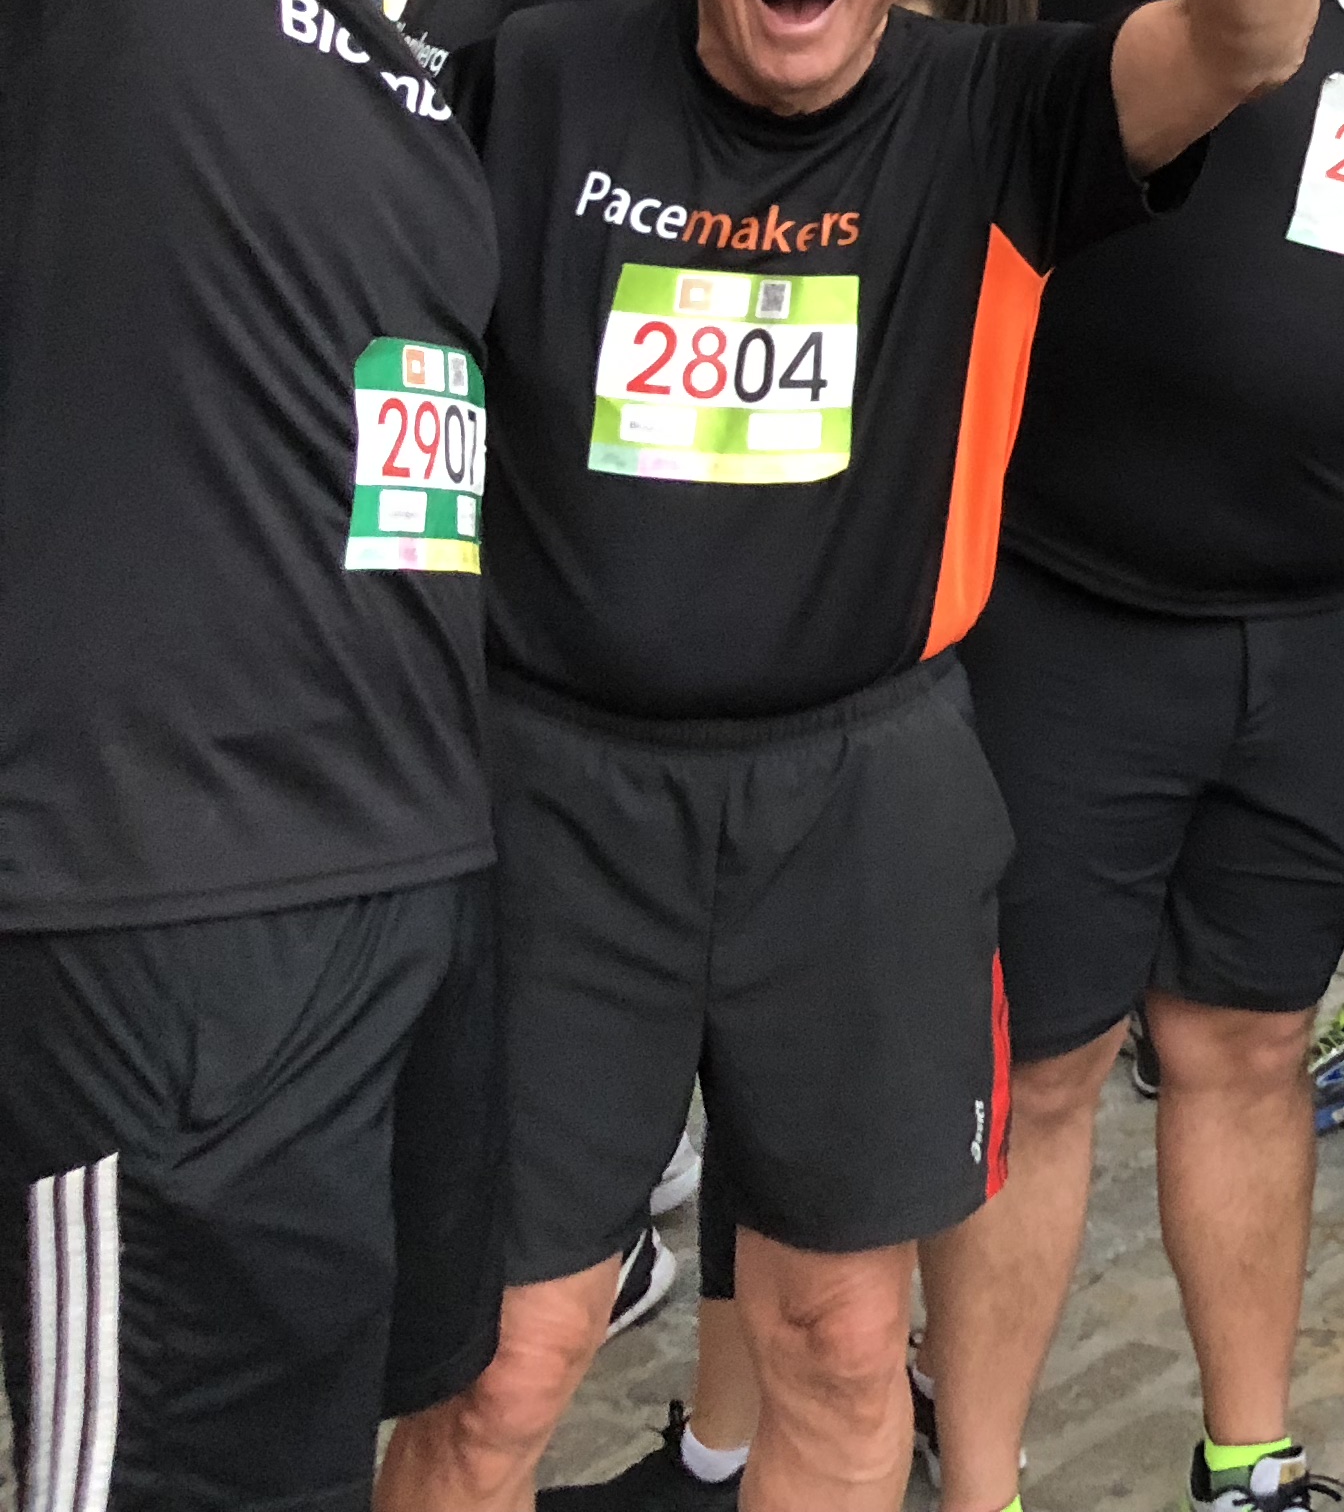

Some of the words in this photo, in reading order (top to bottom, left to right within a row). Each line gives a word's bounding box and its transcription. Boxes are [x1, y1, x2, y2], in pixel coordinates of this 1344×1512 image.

[575, 170, 861, 253] Pacemakers
[626, 320, 828, 404] 2804
[378, 397, 478, 486] 2907
